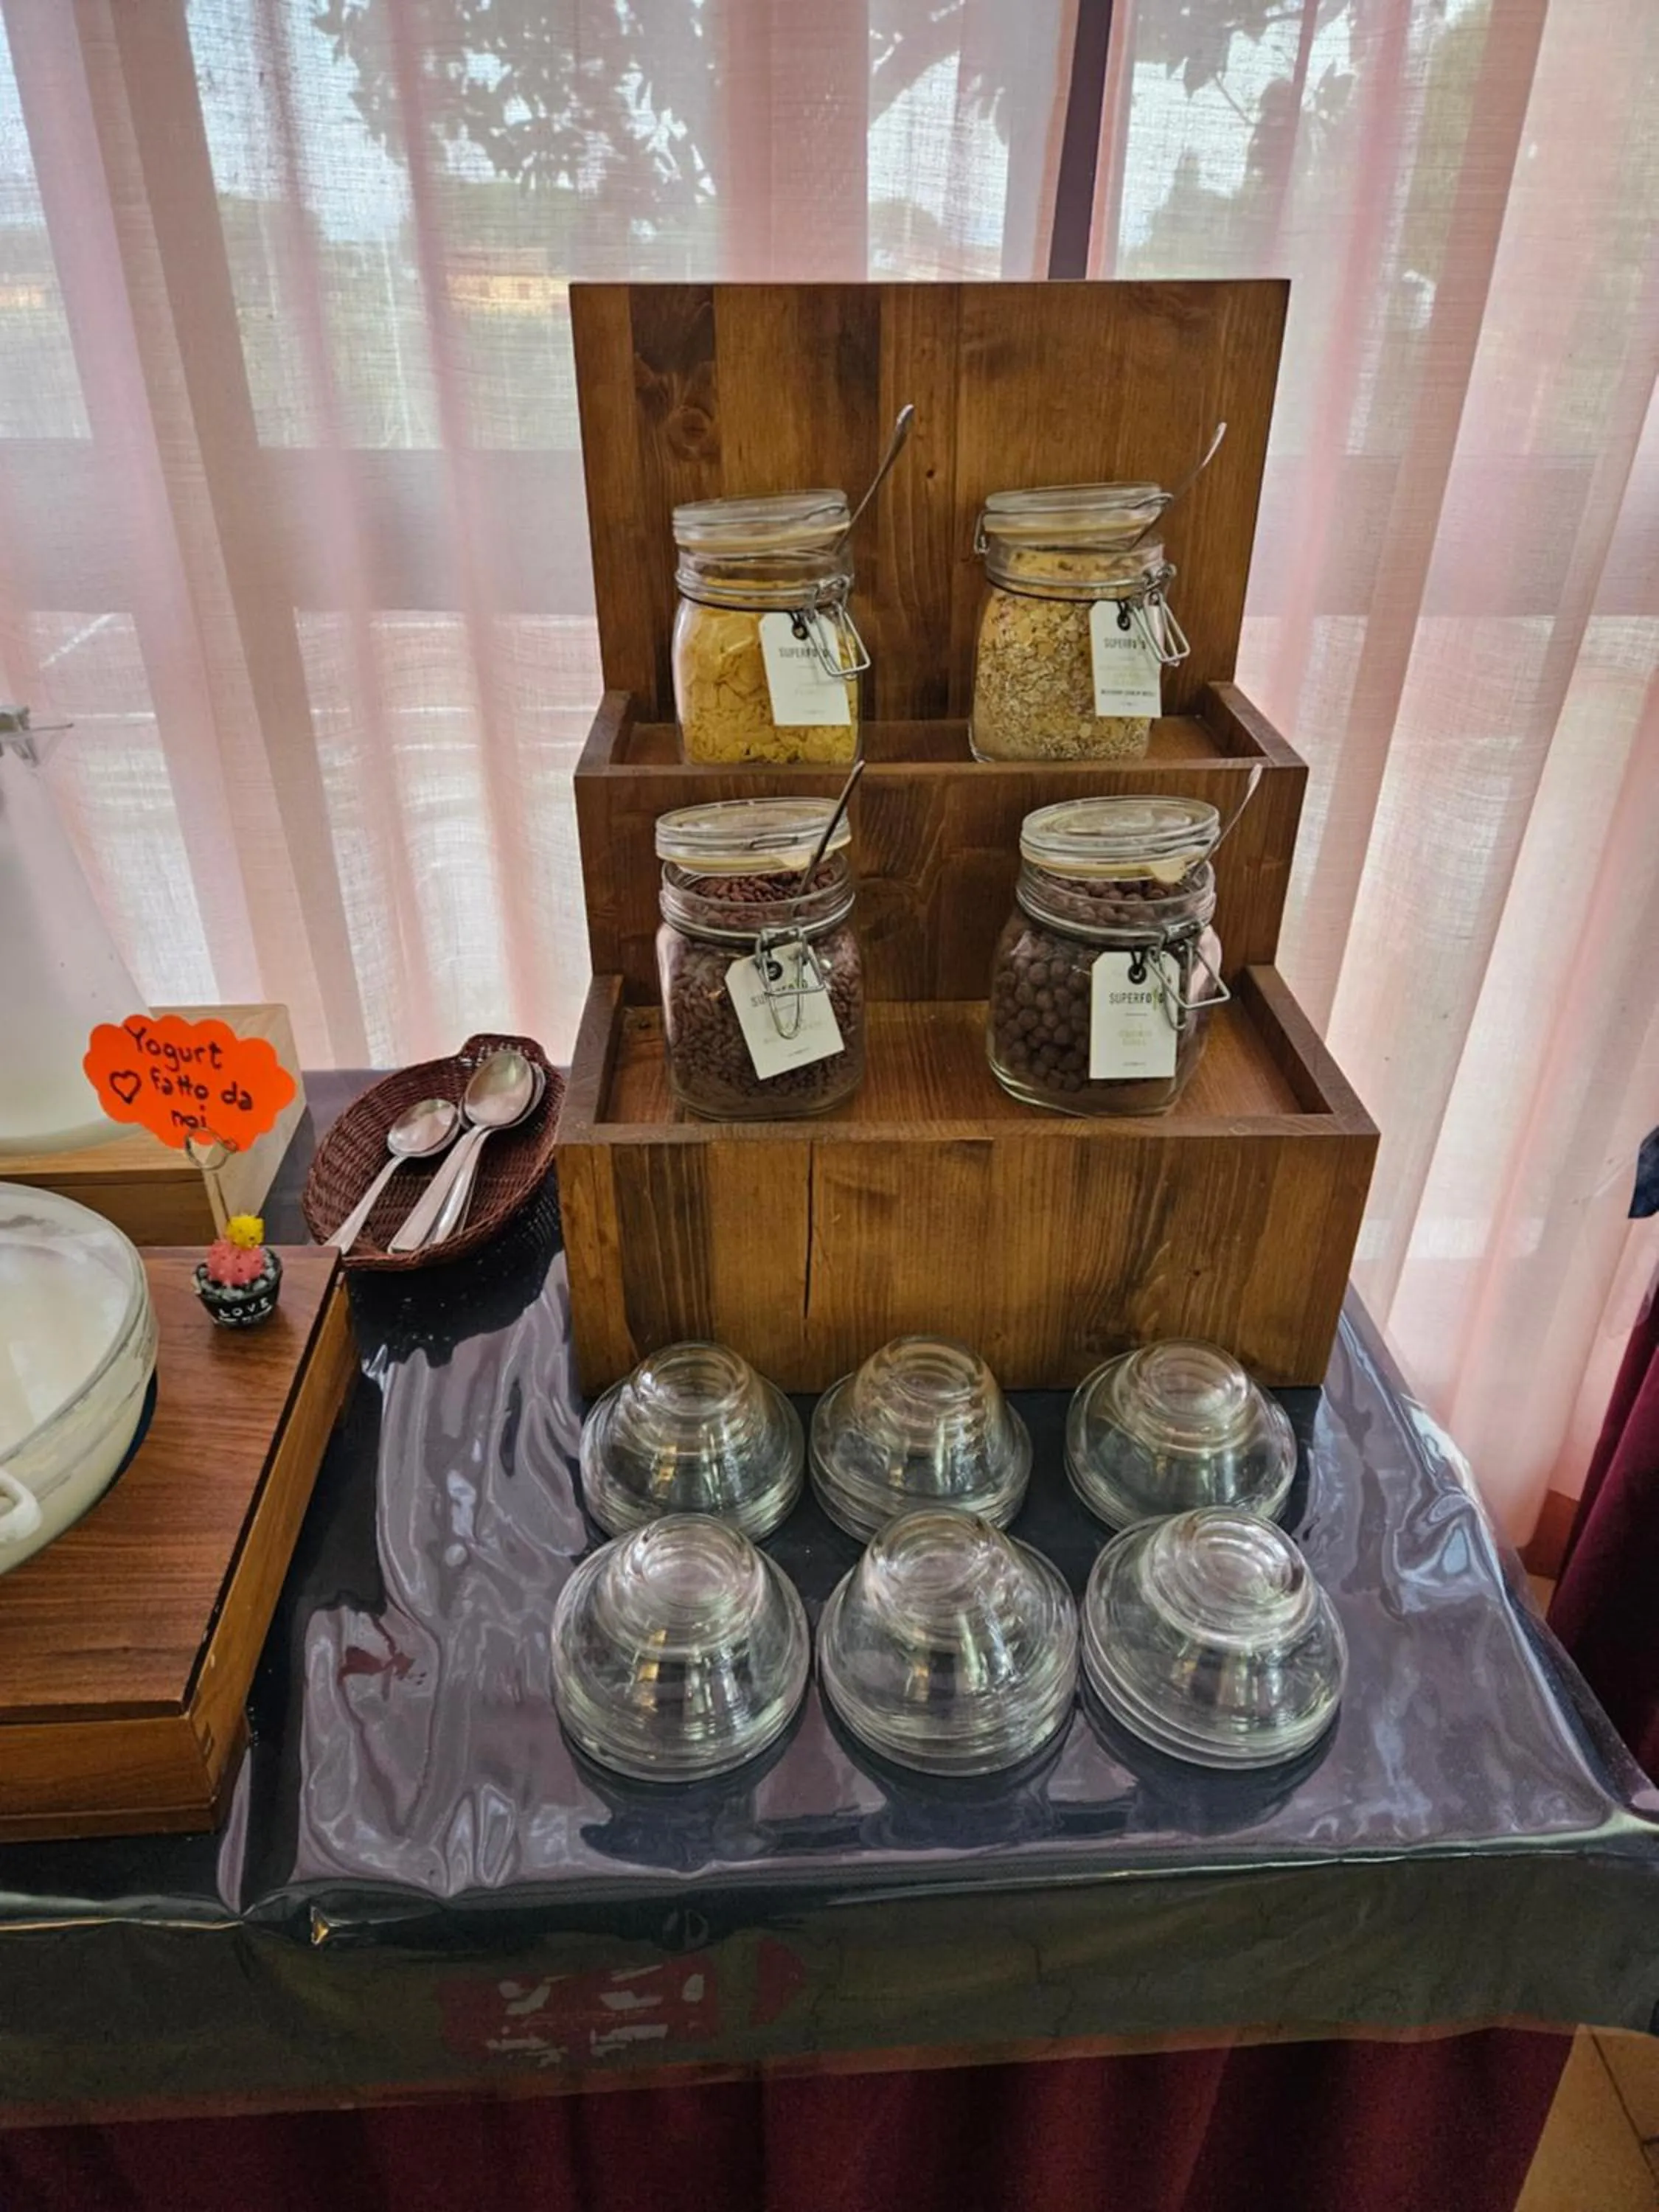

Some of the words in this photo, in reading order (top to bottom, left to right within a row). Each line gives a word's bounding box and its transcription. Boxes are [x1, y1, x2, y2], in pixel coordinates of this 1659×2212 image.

[124, 1026, 223, 1071] Yogurt
[220, 1080, 254, 1111] da
[170, 1105, 208, 1129] noi
[218, 1297, 269, 1317] LOVE
